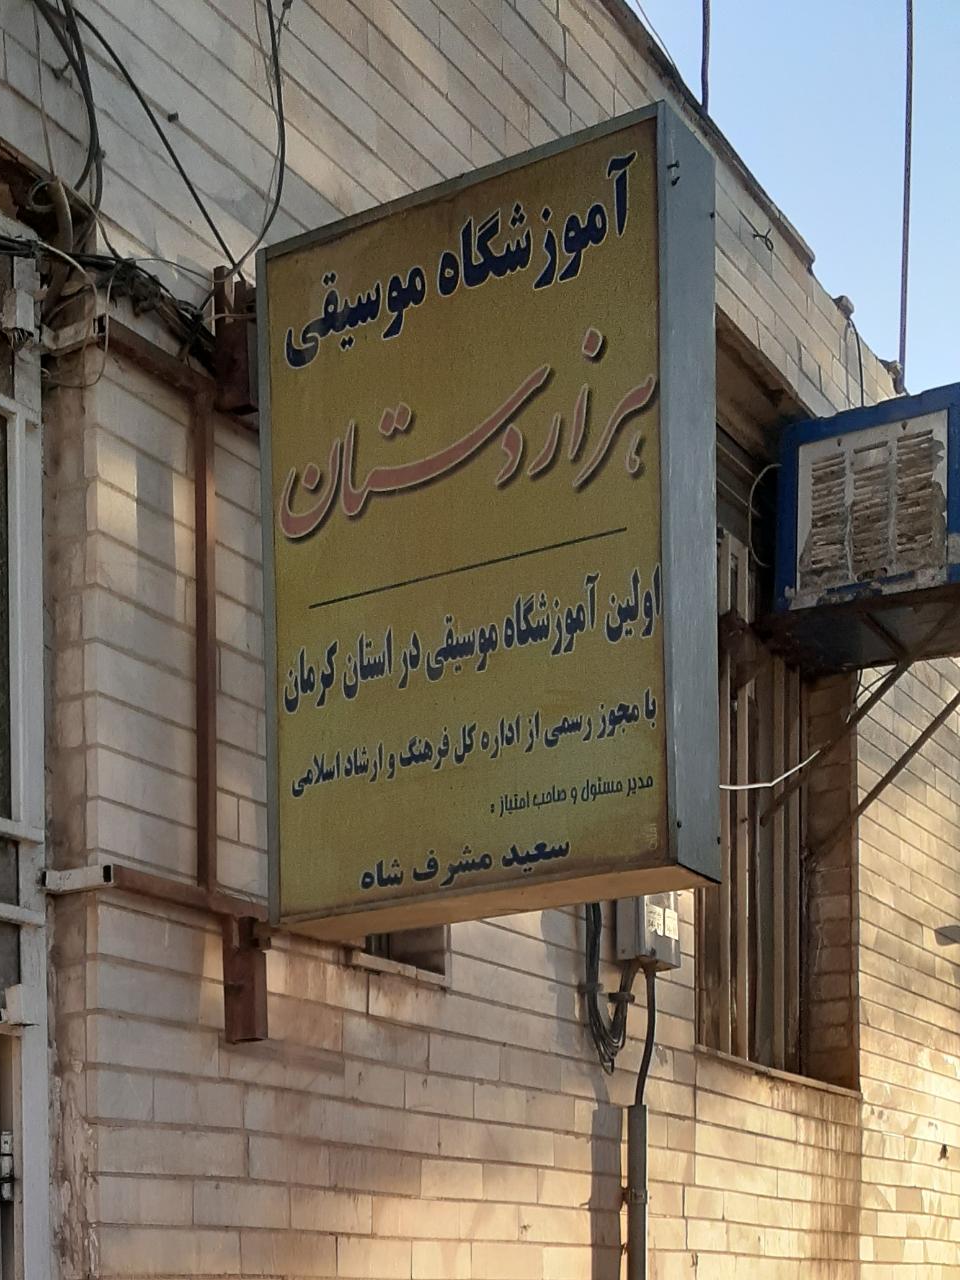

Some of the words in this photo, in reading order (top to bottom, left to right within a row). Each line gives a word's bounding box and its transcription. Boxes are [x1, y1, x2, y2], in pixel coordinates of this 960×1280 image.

[437, 151, 638, 297] آموزشگاه
[285, 265, 427, 369] موسیقی
[503, 572, 600, 656] آموزشگاه
[605, 562, 663, 643] اولین
[343, 625, 393, 699] استان
[398, 631, 421, 689] در
[425, 614, 499, 682] موسیقی
[284, 641, 338, 714] کرمان
[596, 702, 640, 740] مجوز
[643, 687, 658, 729] با
[399, 726, 451, 770] فرهنگ
[453, 722, 477, 765] کل
[480, 713, 521, 759] اداره
[524, 710, 540, 753] از
[543, 714, 593, 749] رسمی
[291, 751, 341, 798] اسلامی
[343, 742, 384, 782] ارشاد
[387, 752, 396, 779] و
[532, 785, 567, 810] صاحب
[570, 786, 578, 805] و
[581, 776, 624, 802] مسئول
[626, 775, 654, 798] مدیر
[359, 857, 405, 890] شاه
[411, 845, 493, 889] مشرف
[500, 839, 572, 874] سعید
